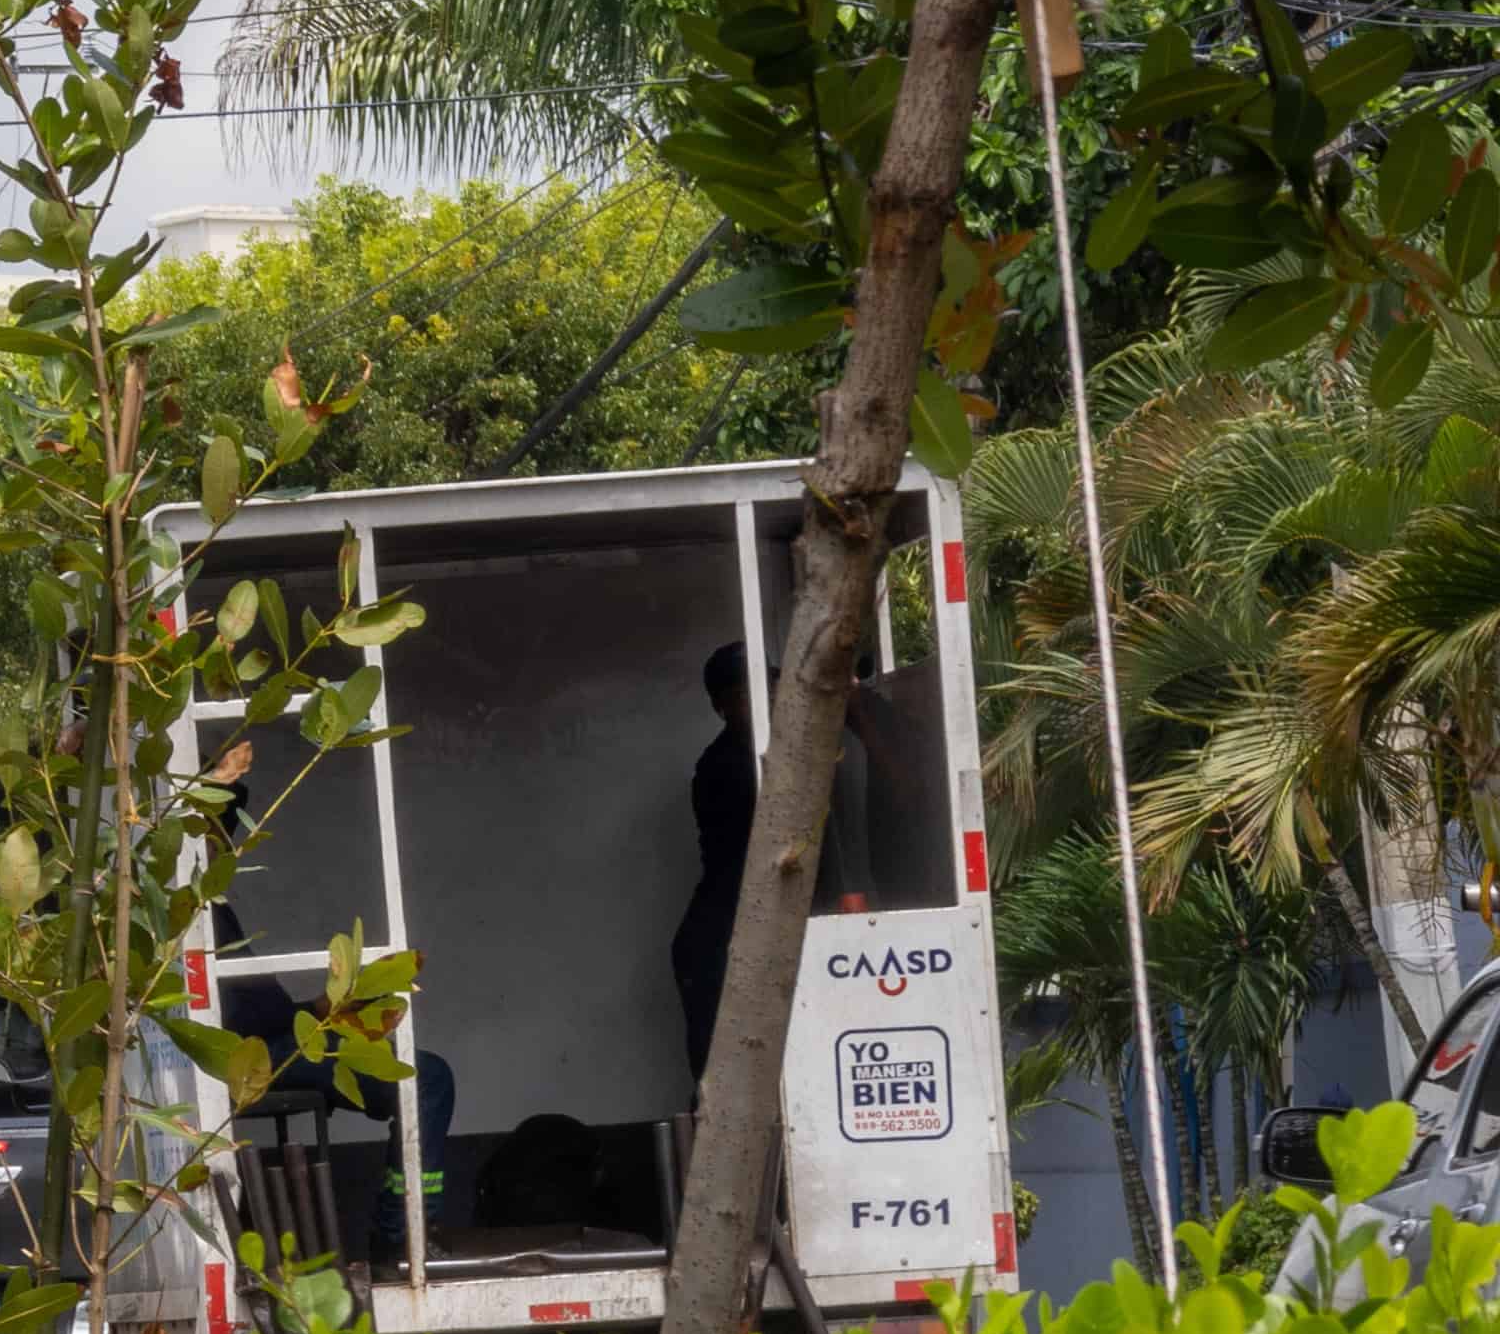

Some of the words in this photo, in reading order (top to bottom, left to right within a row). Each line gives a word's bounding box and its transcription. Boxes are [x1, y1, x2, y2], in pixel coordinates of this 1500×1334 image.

[827, 946, 953, 979] CAASD
[848, 1041, 889, 1063] YO
[855, 1063, 931, 1078] MANEJO
[853, 1080, 937, 1107] BIEN
[852, 1198, 950, 1228] F-761
